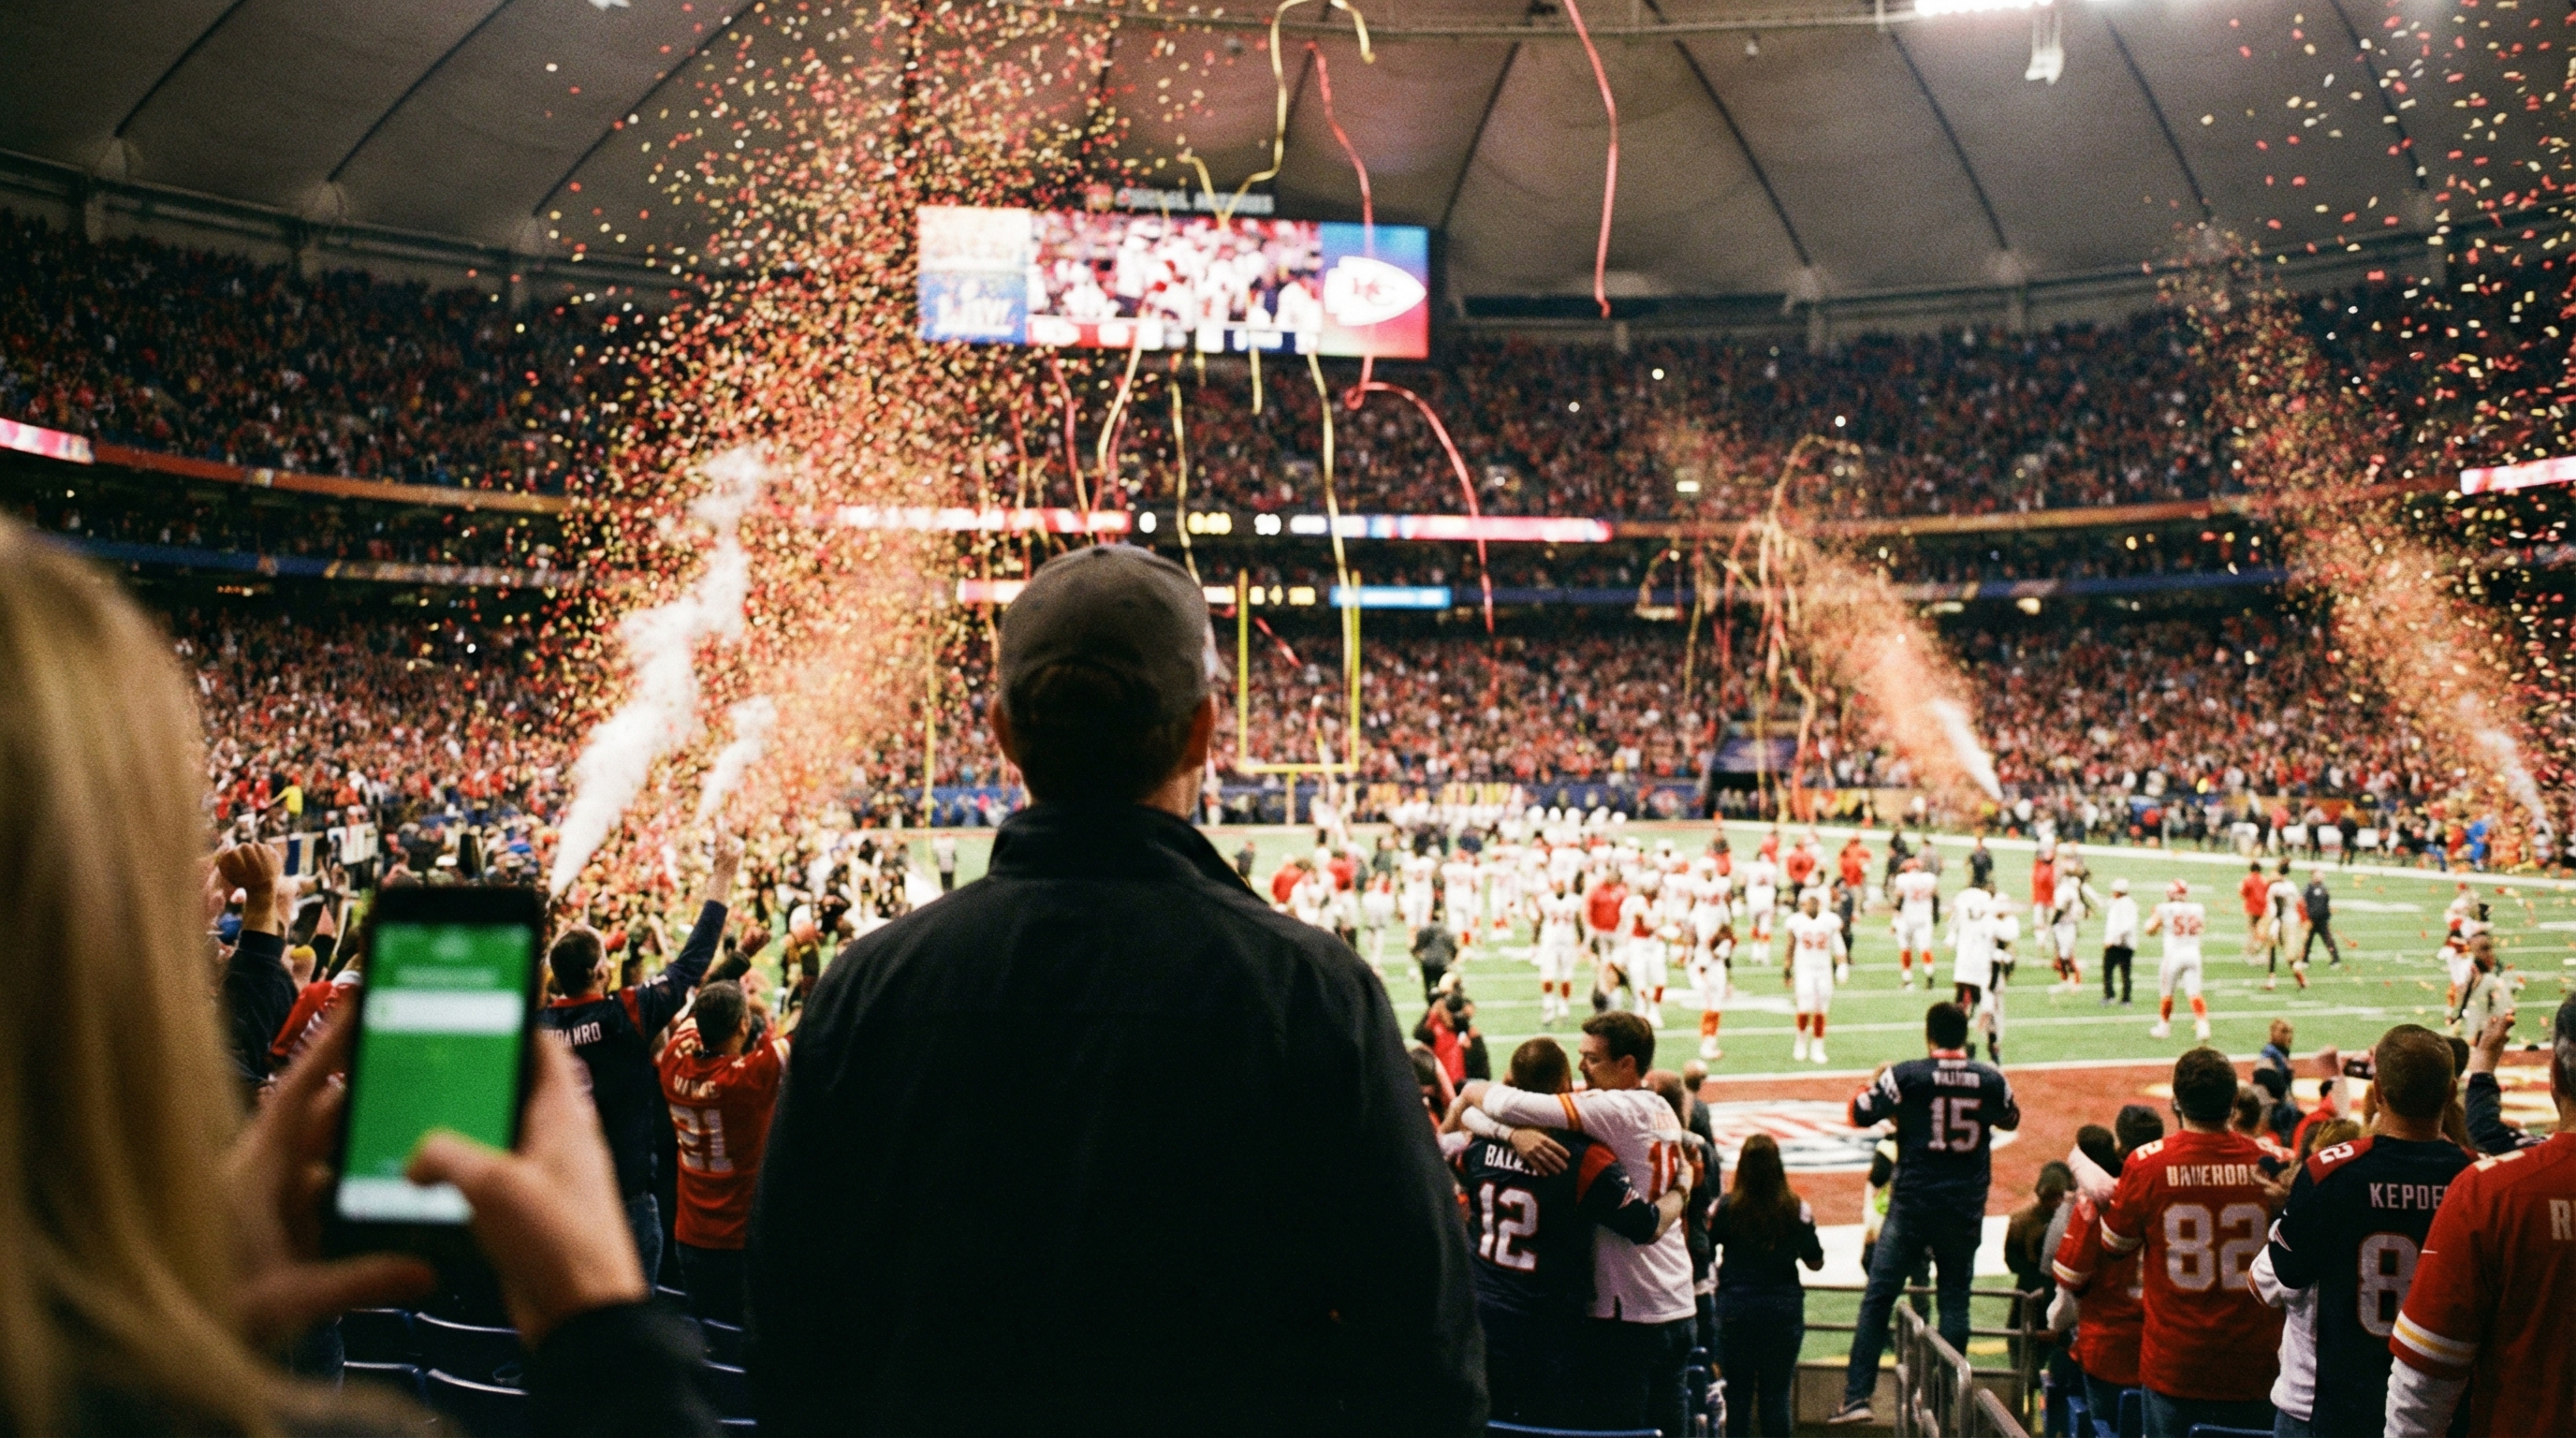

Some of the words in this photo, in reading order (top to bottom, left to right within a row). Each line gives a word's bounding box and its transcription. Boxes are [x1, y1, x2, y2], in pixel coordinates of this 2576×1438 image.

[1928, 1095, 1983, 1152] 15
[1478, 1181, 1538, 1272] 12
[2162, 1202, 2268, 1291] 82
[2549, 1198, 2576, 1241] R
